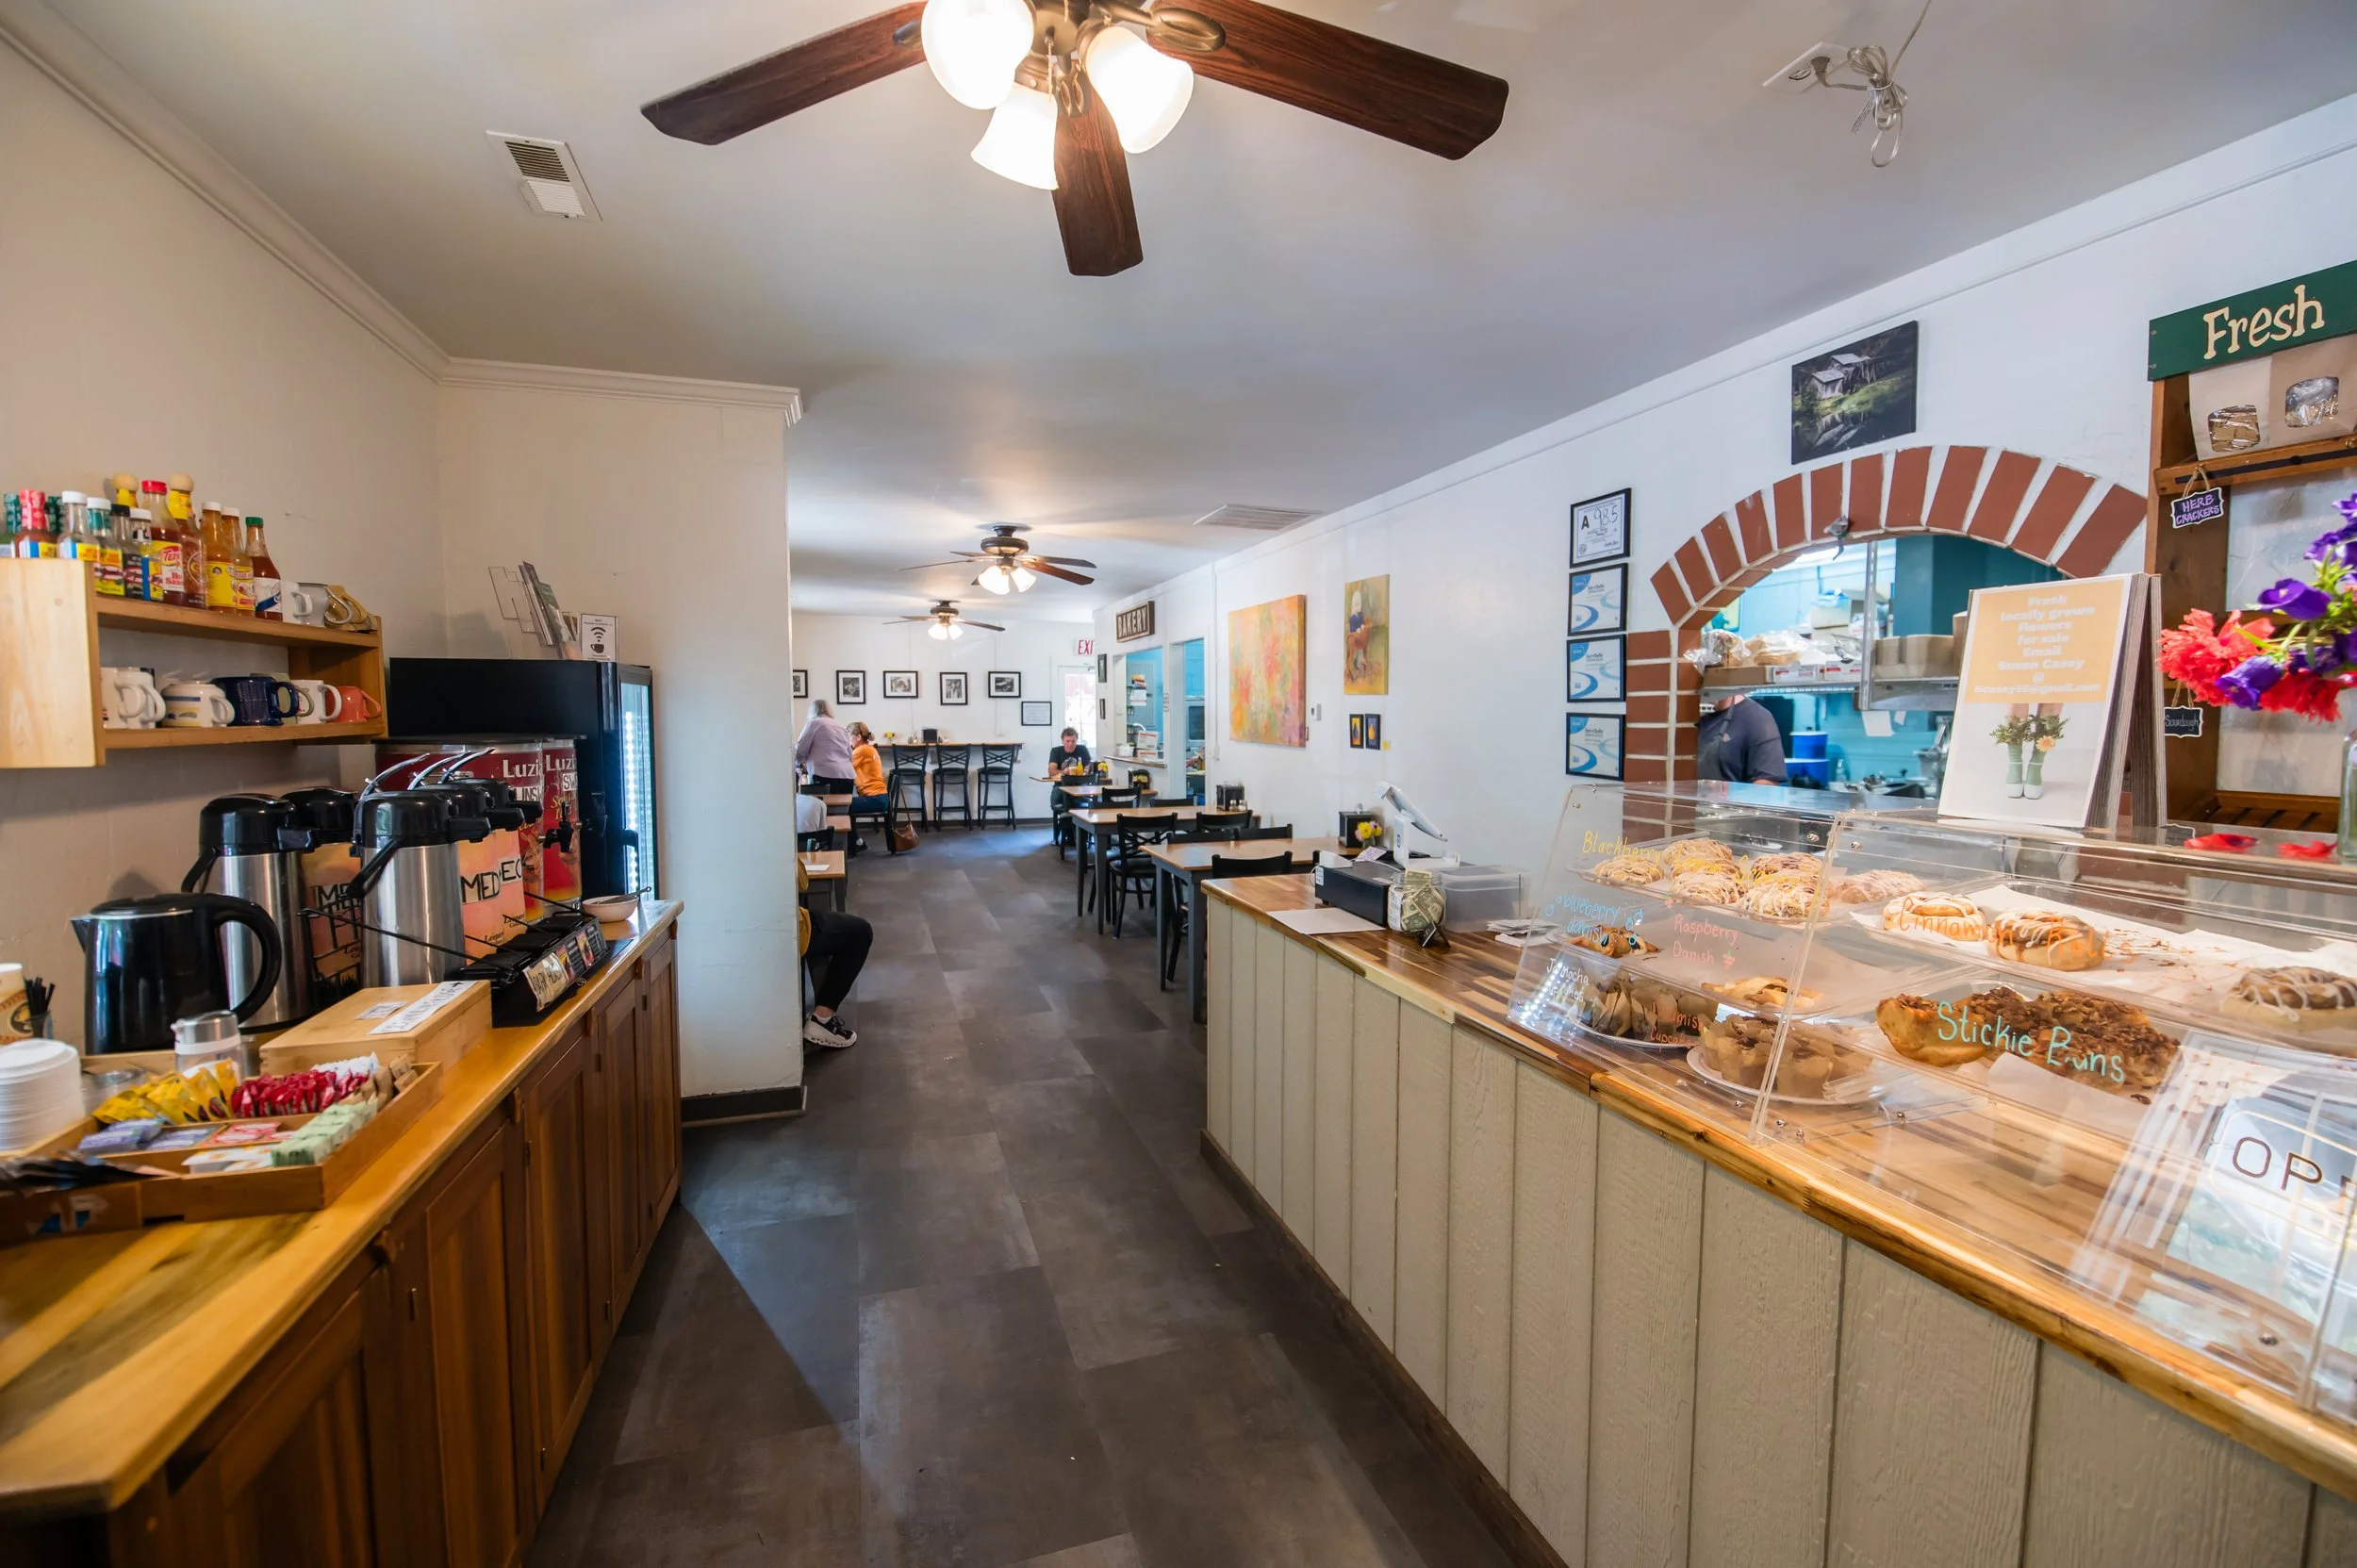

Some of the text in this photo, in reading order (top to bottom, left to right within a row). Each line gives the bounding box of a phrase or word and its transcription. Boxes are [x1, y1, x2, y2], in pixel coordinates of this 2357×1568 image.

[2202, 284, 2325, 360] Fresh
[2176, 504, 2220, 525] CRACKERS
[2182, 494, 2215, 513] HERB
[1581, 515, 1590, 530] A
[1593, 504, 1619, 529] 98.5
[2028, 595, 2068, 606] Fresh
[1117, 606, 1148, 638] BAKERY
[2000, 606, 2095, 621] locally grown
[2018, 634, 2070, 645] for sale
[2022, 646, 2062, 657] Email
[1997, 659, 2085, 670] Susan Casey
[2165, 714, 2200, 732] Sourdough
[1582, 830, 1662, 874] Blackberry
[1563, 890, 1622, 925] blueberry
[1567, 915, 1609, 946] danish
[1673, 912, 1739, 946] Raspberry
[1899, 896, 2014, 946] Cinnamon
[1672, 941, 1715, 966] Danish
[1937, 999, 2034, 1057] Stickie
